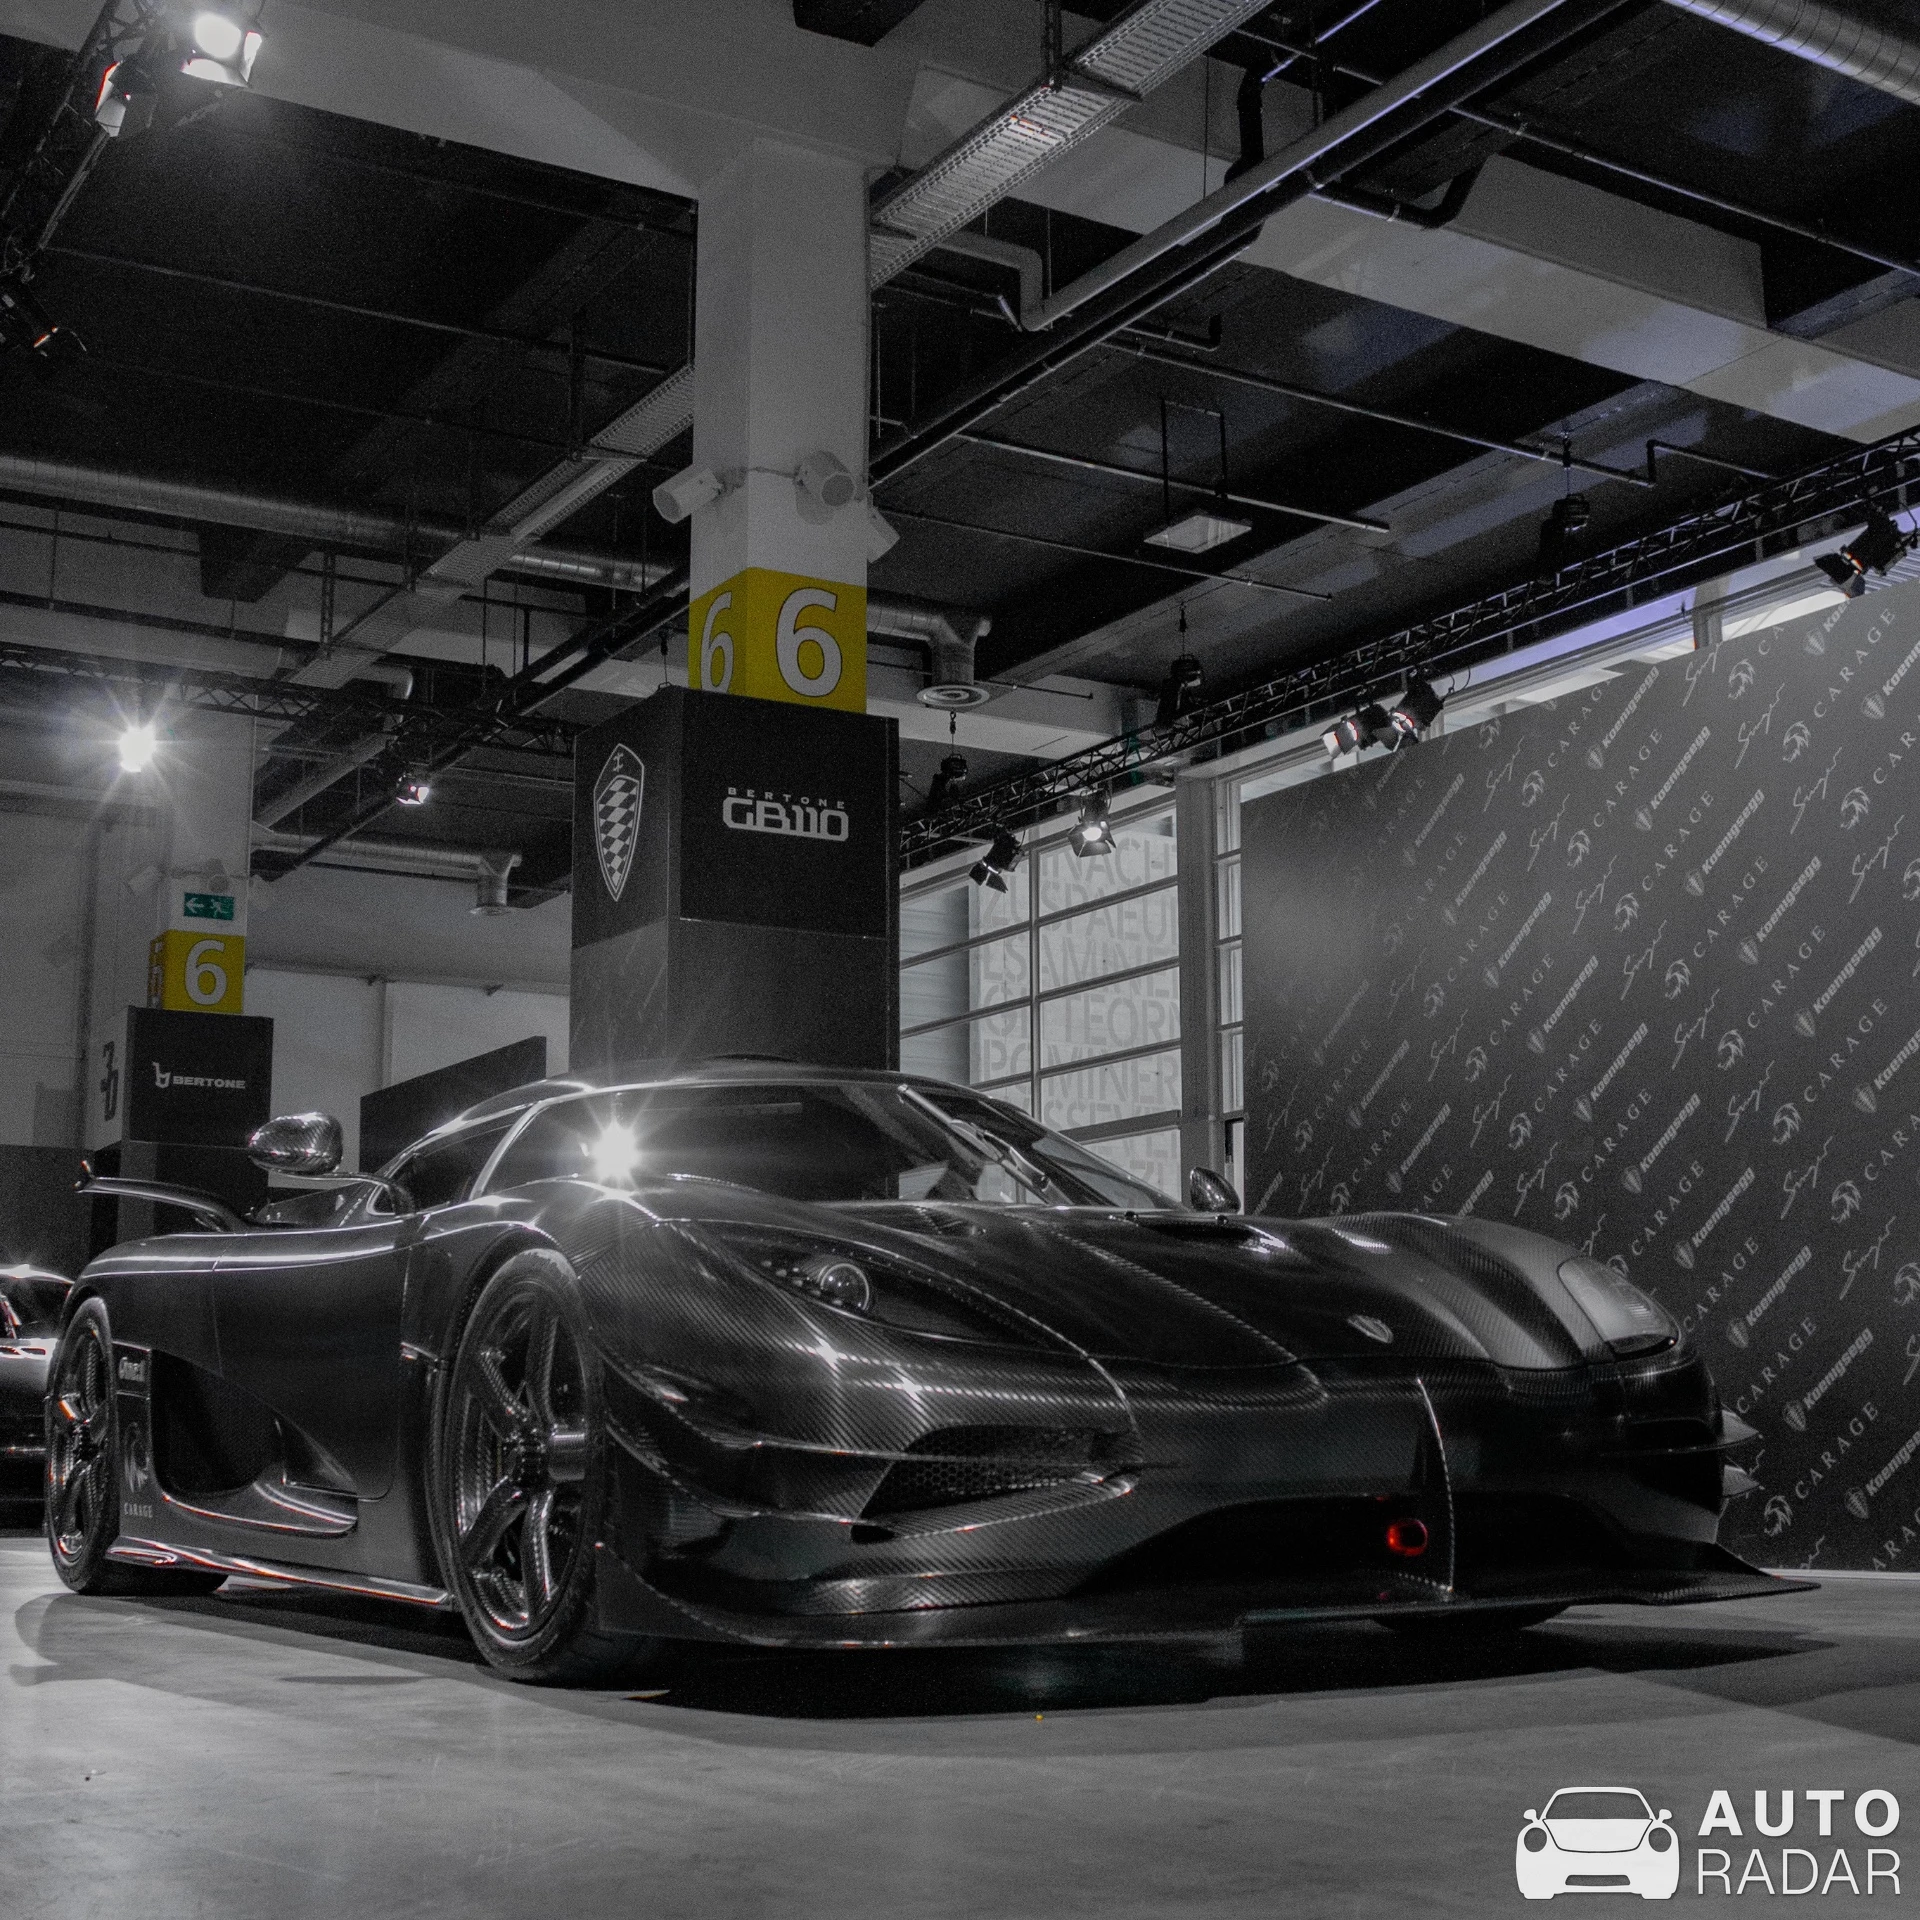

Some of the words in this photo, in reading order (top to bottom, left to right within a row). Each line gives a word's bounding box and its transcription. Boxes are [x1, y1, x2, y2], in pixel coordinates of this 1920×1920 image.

[701, 590, 735, 694] 6
[774, 587, 844, 698] 6
[1602, 666, 1660, 748] Koenigsegg
[727, 786, 846, 810] BERTONE
[1651, 726, 1711, 809] Koenigsegg
[722, 796, 849, 842] GB110
[1702, 789, 1766, 875] Koenigsegg
[1498, 891, 1552, 968] Koenigsegg
[1756, 856, 1822, 942] Koenigsegg
[184, 939, 228, 1006] 6
[1543, 955, 1599, 1033] Koenigsegg
[1813, 926, 1883, 1014] Koenigsegg
[172, 1075, 246, 1090] BERTONE
[1590, 1022, 1649, 1101] Koenigsegg
[1639, 1093, 1701, 1173] Koenigsegg
[1692, 1167, 1755, 1247] Koenigsegg
[1745, 1245, 1813, 1326] Koenigsegg
[1802, 1327, 1874, 1411] Koenigsegg
